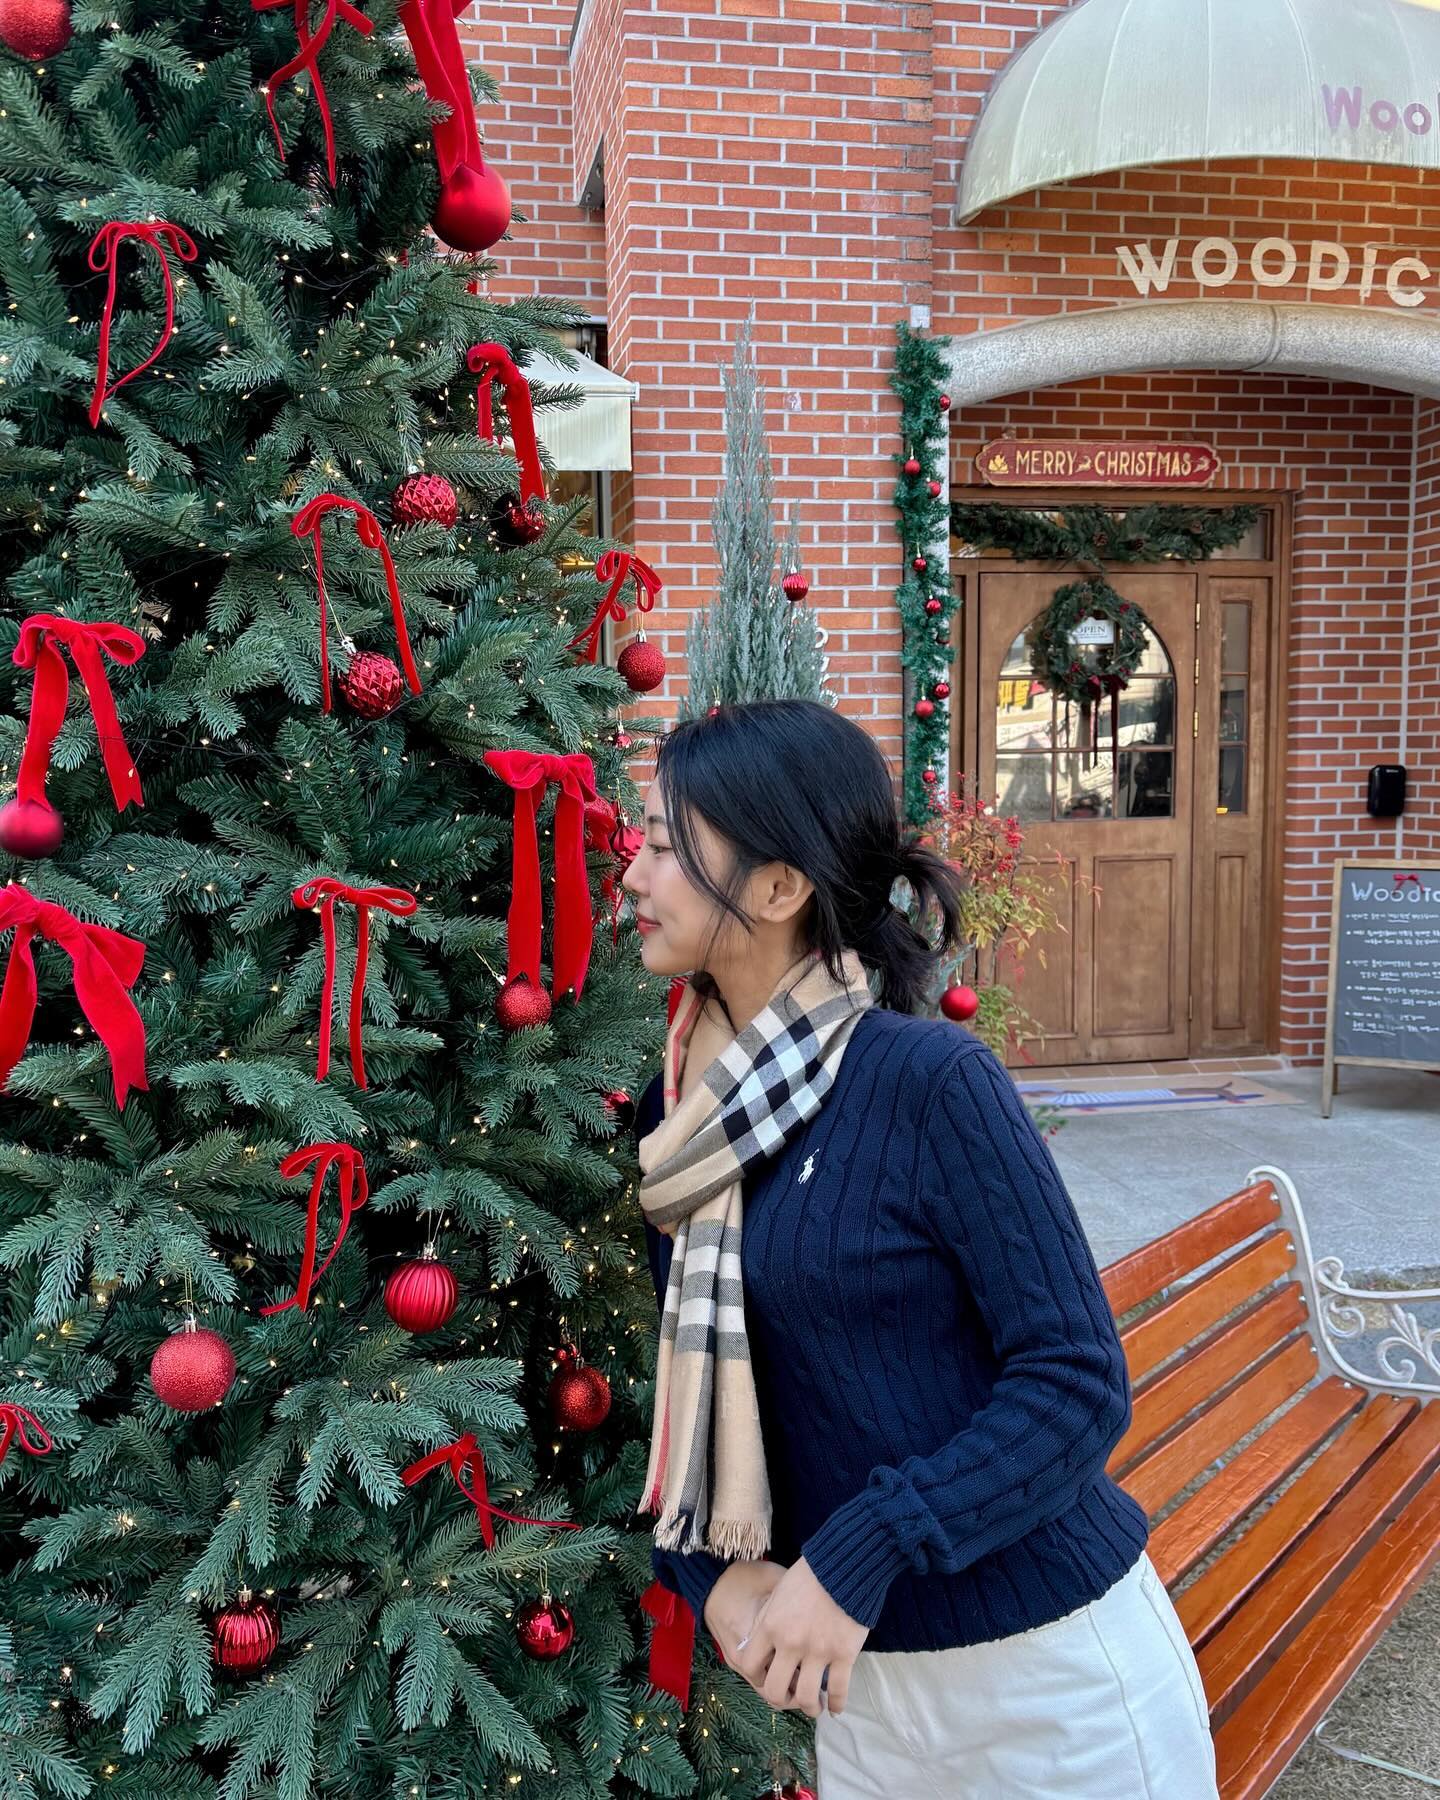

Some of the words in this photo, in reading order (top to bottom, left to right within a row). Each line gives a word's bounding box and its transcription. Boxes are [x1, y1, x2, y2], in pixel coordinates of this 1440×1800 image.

[1321, 83, 1440, 136] Woo
[1015, 450, 1077, 476] MERRY
[1094, 450, 1192, 477] CHRISTMAS
